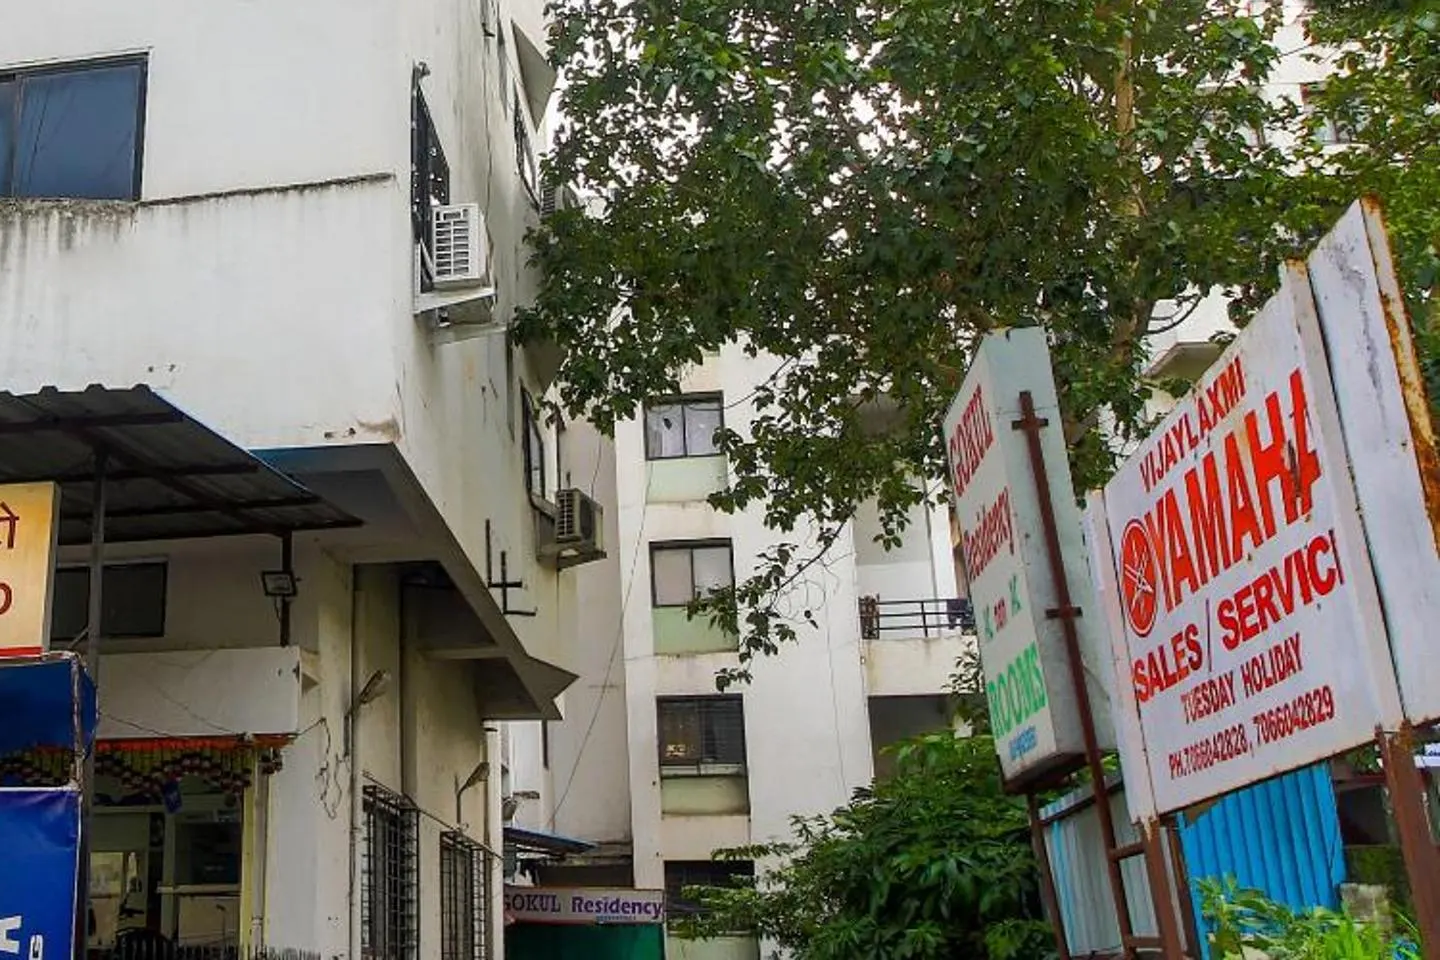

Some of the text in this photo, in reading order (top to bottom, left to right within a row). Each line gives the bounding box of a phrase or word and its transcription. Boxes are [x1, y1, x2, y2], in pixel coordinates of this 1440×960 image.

[1140, 356, 1246, 493] VIJAYLAXMI
[1134, 624, 1203, 702] SALES
[1217, 528, 1345, 651] SERVIC
[1181, 631, 1303, 725] TUESDAY HOLIDAY
[572, 896, 663, 919] Residency
